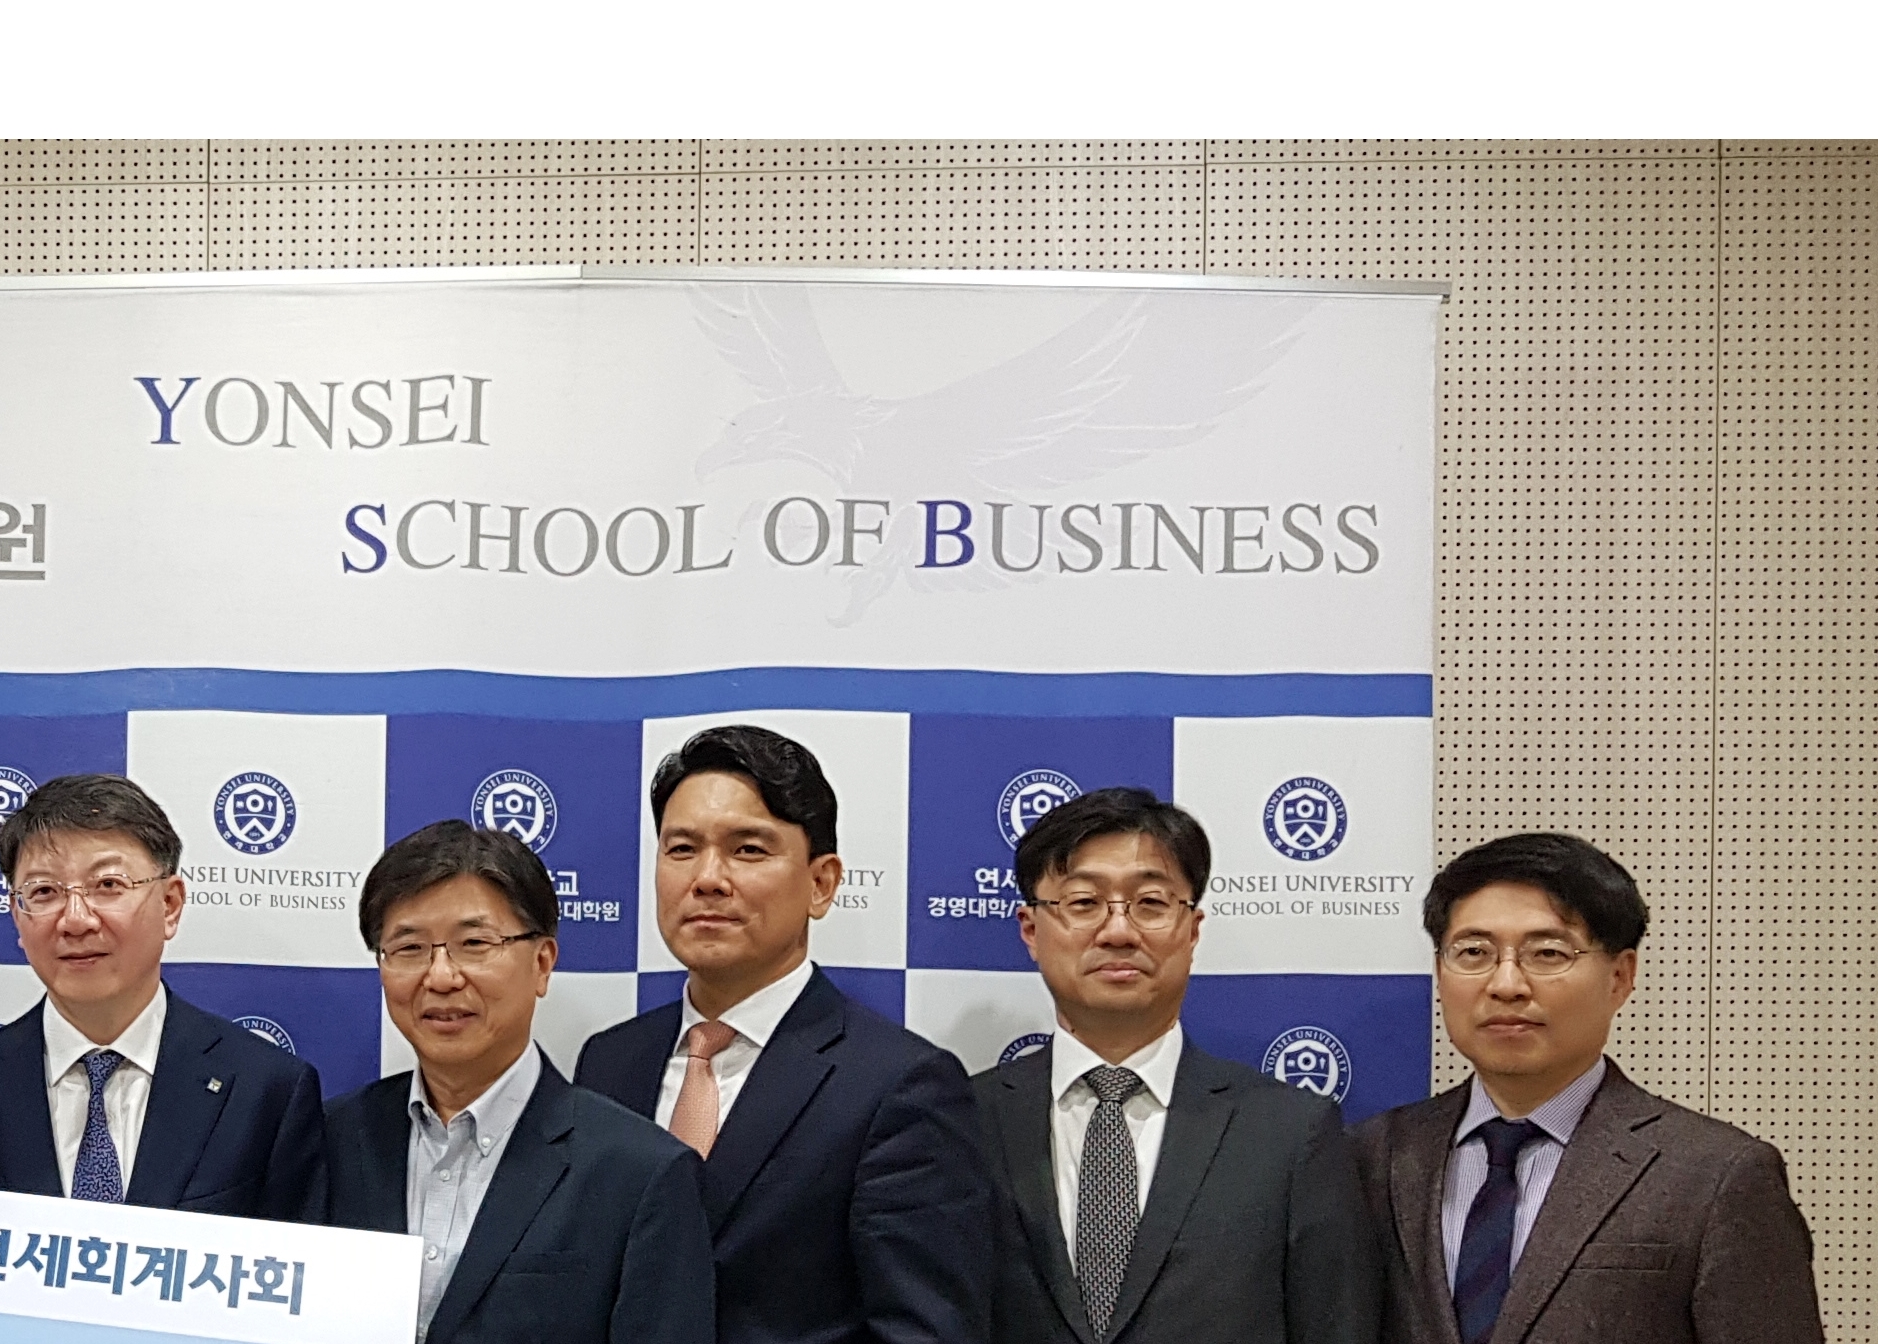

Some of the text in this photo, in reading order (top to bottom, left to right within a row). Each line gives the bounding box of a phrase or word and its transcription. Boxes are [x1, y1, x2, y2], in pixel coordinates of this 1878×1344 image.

[133, 374, 492, 450] YONSEI
[341, 496, 1380, 577] SCHOOL OF BUSINESS
[216, 774, 295, 816] YONSEI UNIVERSITY
[475, 773, 554, 817] YONSEI UNIVERSITY
[1002, 773, 1078, 813] YONSEI UNIVERS
[1265, 778, 1346, 821] YONSEI UNIVERSITY
[180, 866, 361, 888] NSEI UNIVERSITY
[1210, 875, 1414, 893] ONSEI UNIVERSITY
[187, 891, 346, 910] HOOL OF BUSINESS
[1211, 901, 1400, 916] SCHOOL OF BUSINESS
[242, 1020, 291, 1053] UNIVERSI
[1296, 1030, 1348, 1073] UNIVERSITY
